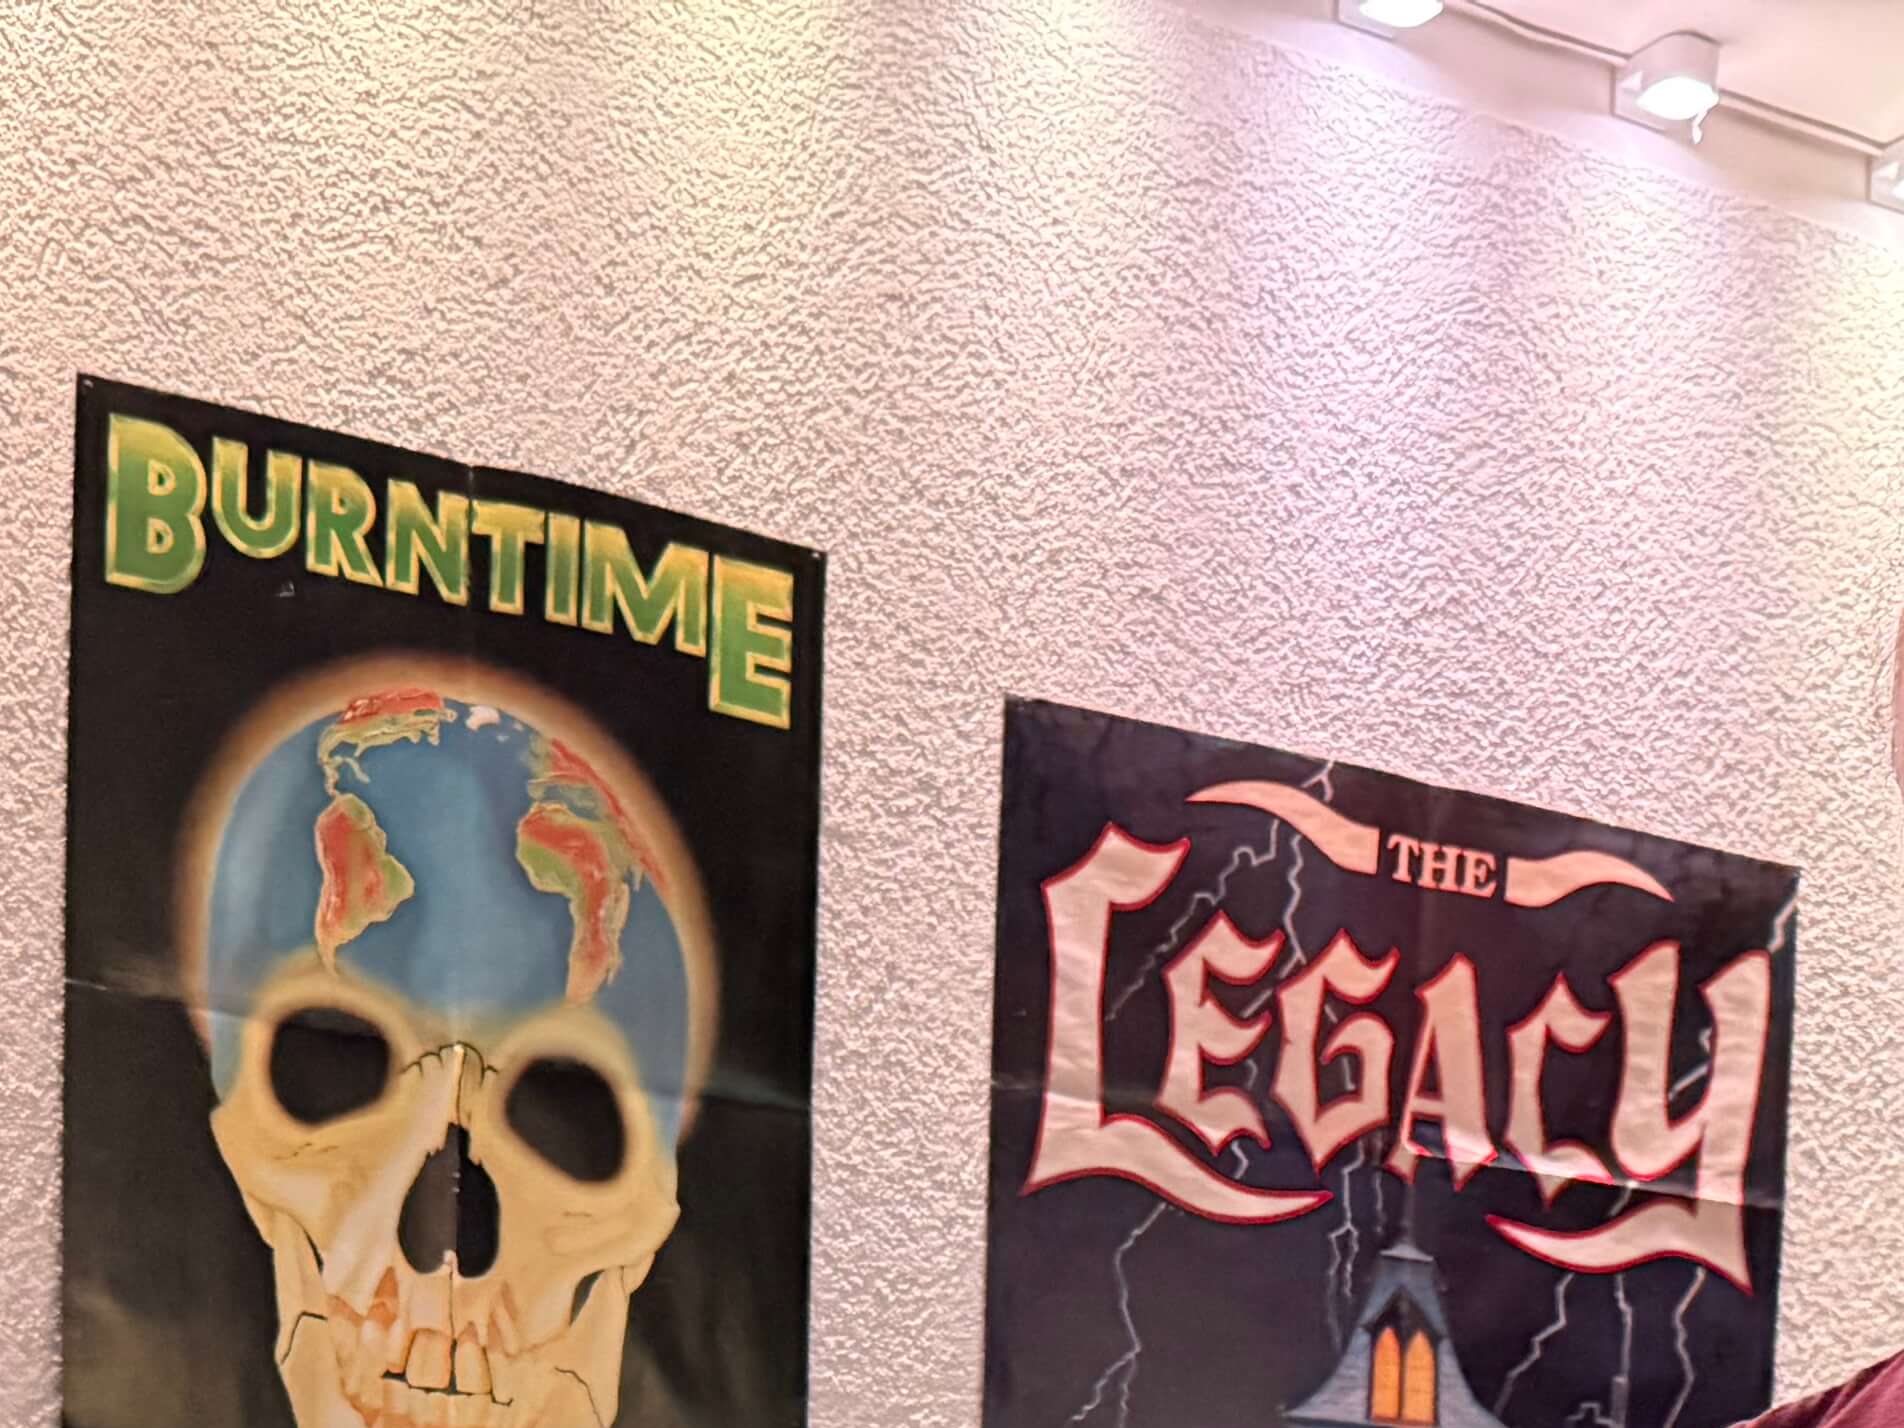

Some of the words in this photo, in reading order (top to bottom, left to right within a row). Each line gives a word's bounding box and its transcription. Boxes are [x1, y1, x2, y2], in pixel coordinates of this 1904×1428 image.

[104, 412, 794, 730] BURNTIME
[1386, 832, 1497, 897] THE
[1020, 822, 1772, 1296] LEGACY
